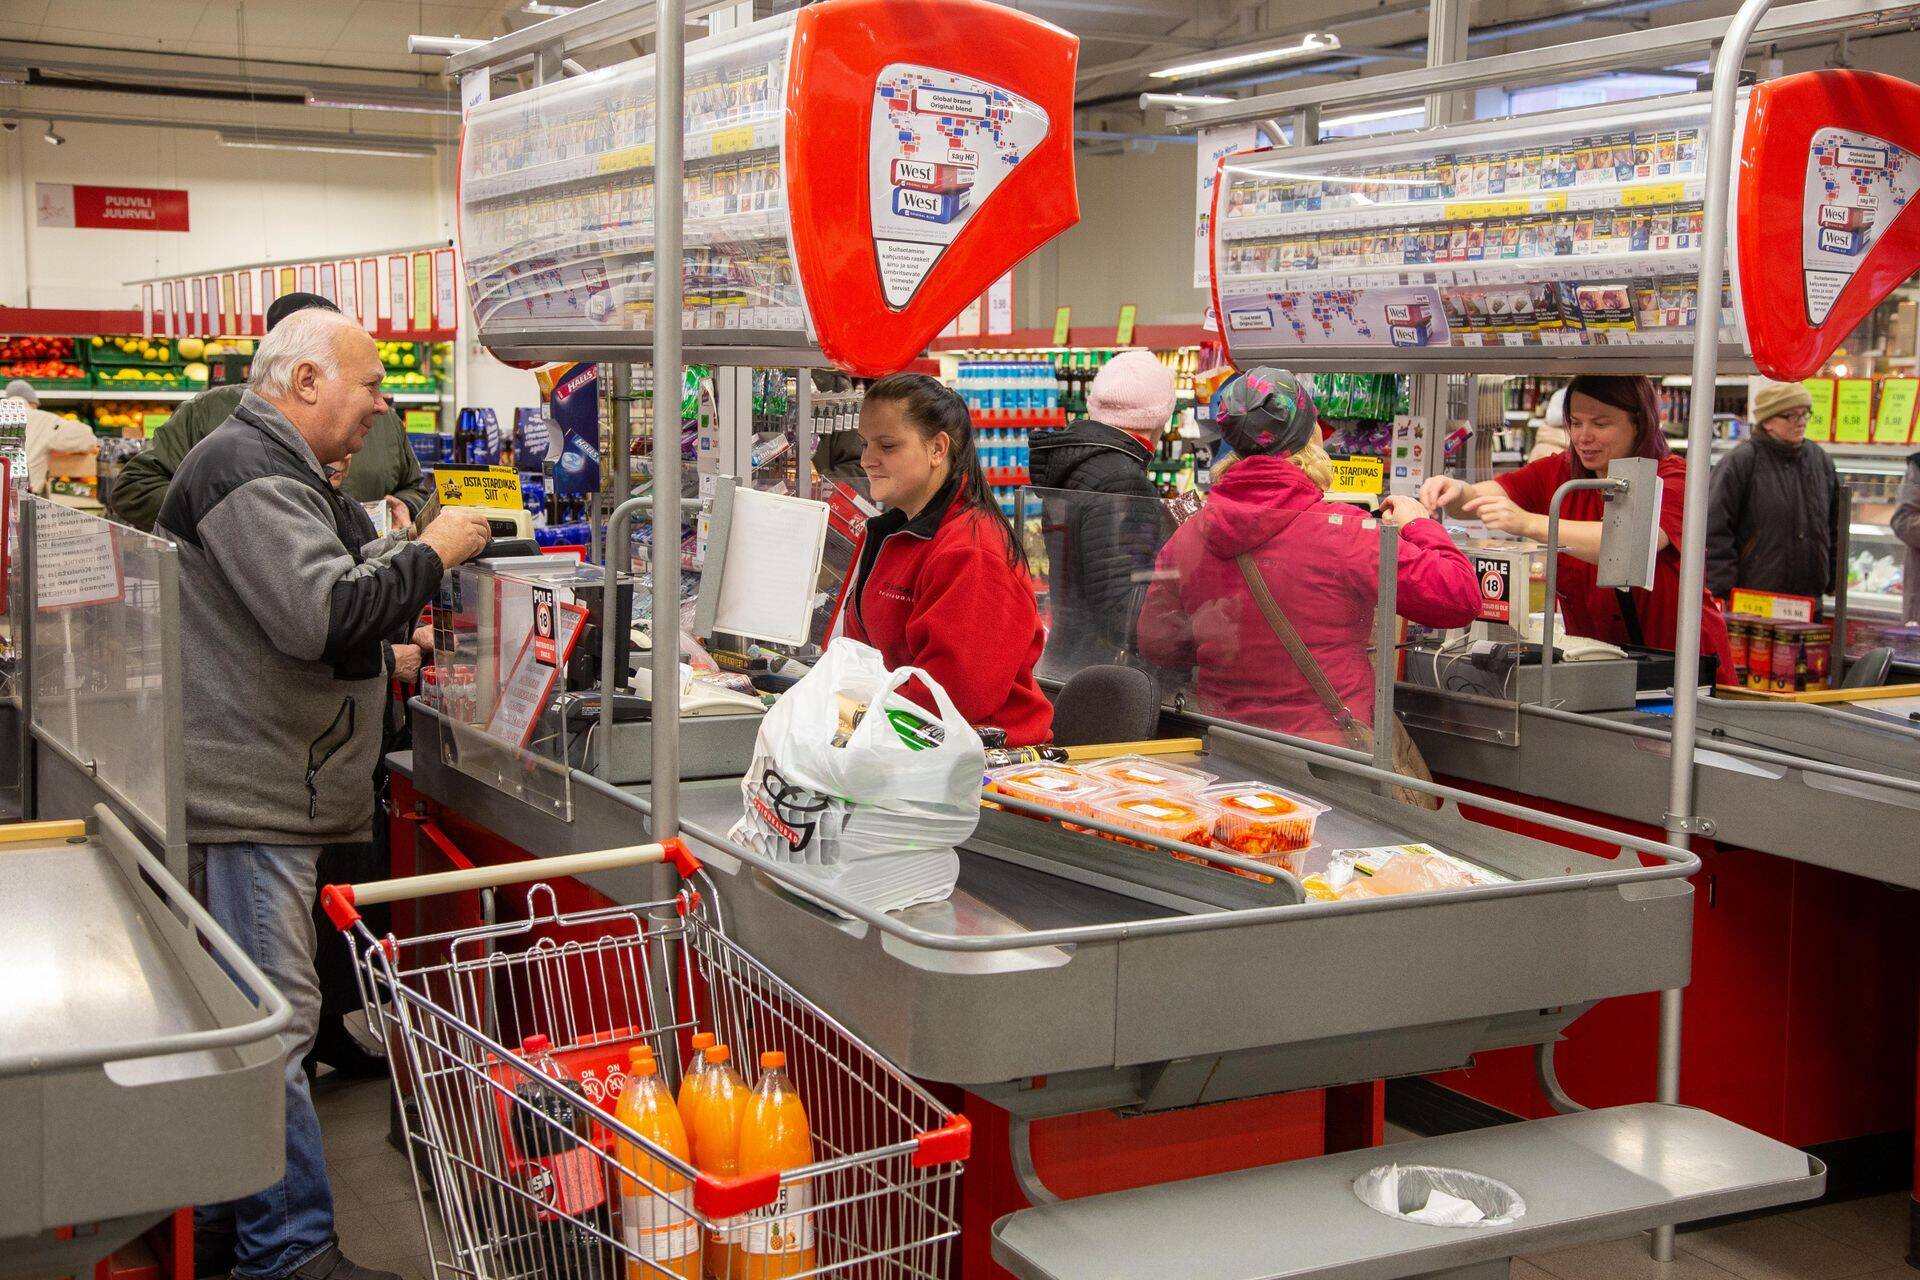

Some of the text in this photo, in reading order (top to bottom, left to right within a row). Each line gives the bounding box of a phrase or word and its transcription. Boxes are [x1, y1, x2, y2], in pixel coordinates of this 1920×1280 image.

[932, 95, 952, 103] Global
[930, 102, 973, 113] Original blend
[951, 153, 975, 162] say Hi!
[900, 163, 931, 181] West
[105, 195, 151, 208] PUUVILI
[904, 192, 938, 212] West
[102, 208, 155, 220] JUURVILI
[1825, 208, 1846, 221] West
[1825, 231, 1849, 246] West
[888, 246, 925, 254] Suitsetamine
[882, 254, 911, 262] kahjustab
[1389, 307, 1408, 319] West
[1395, 329, 1416, 341] West
[567, 371, 593, 392] HALLS
[575, 438, 599, 458] HALLS
[1340, 466, 1379, 478] STARDIKAS
[463, 476, 517, 491] OSTA STARDIKAS
[1339, 475, 1354, 486] SIIT
[484, 489, 499, 501] SIIT
[1477, 560, 1508, 575] POLE
[1486, 579, 1499, 592] 18
[533, 589, 552, 607] POLE
[539, 613, 548, 628] 18
